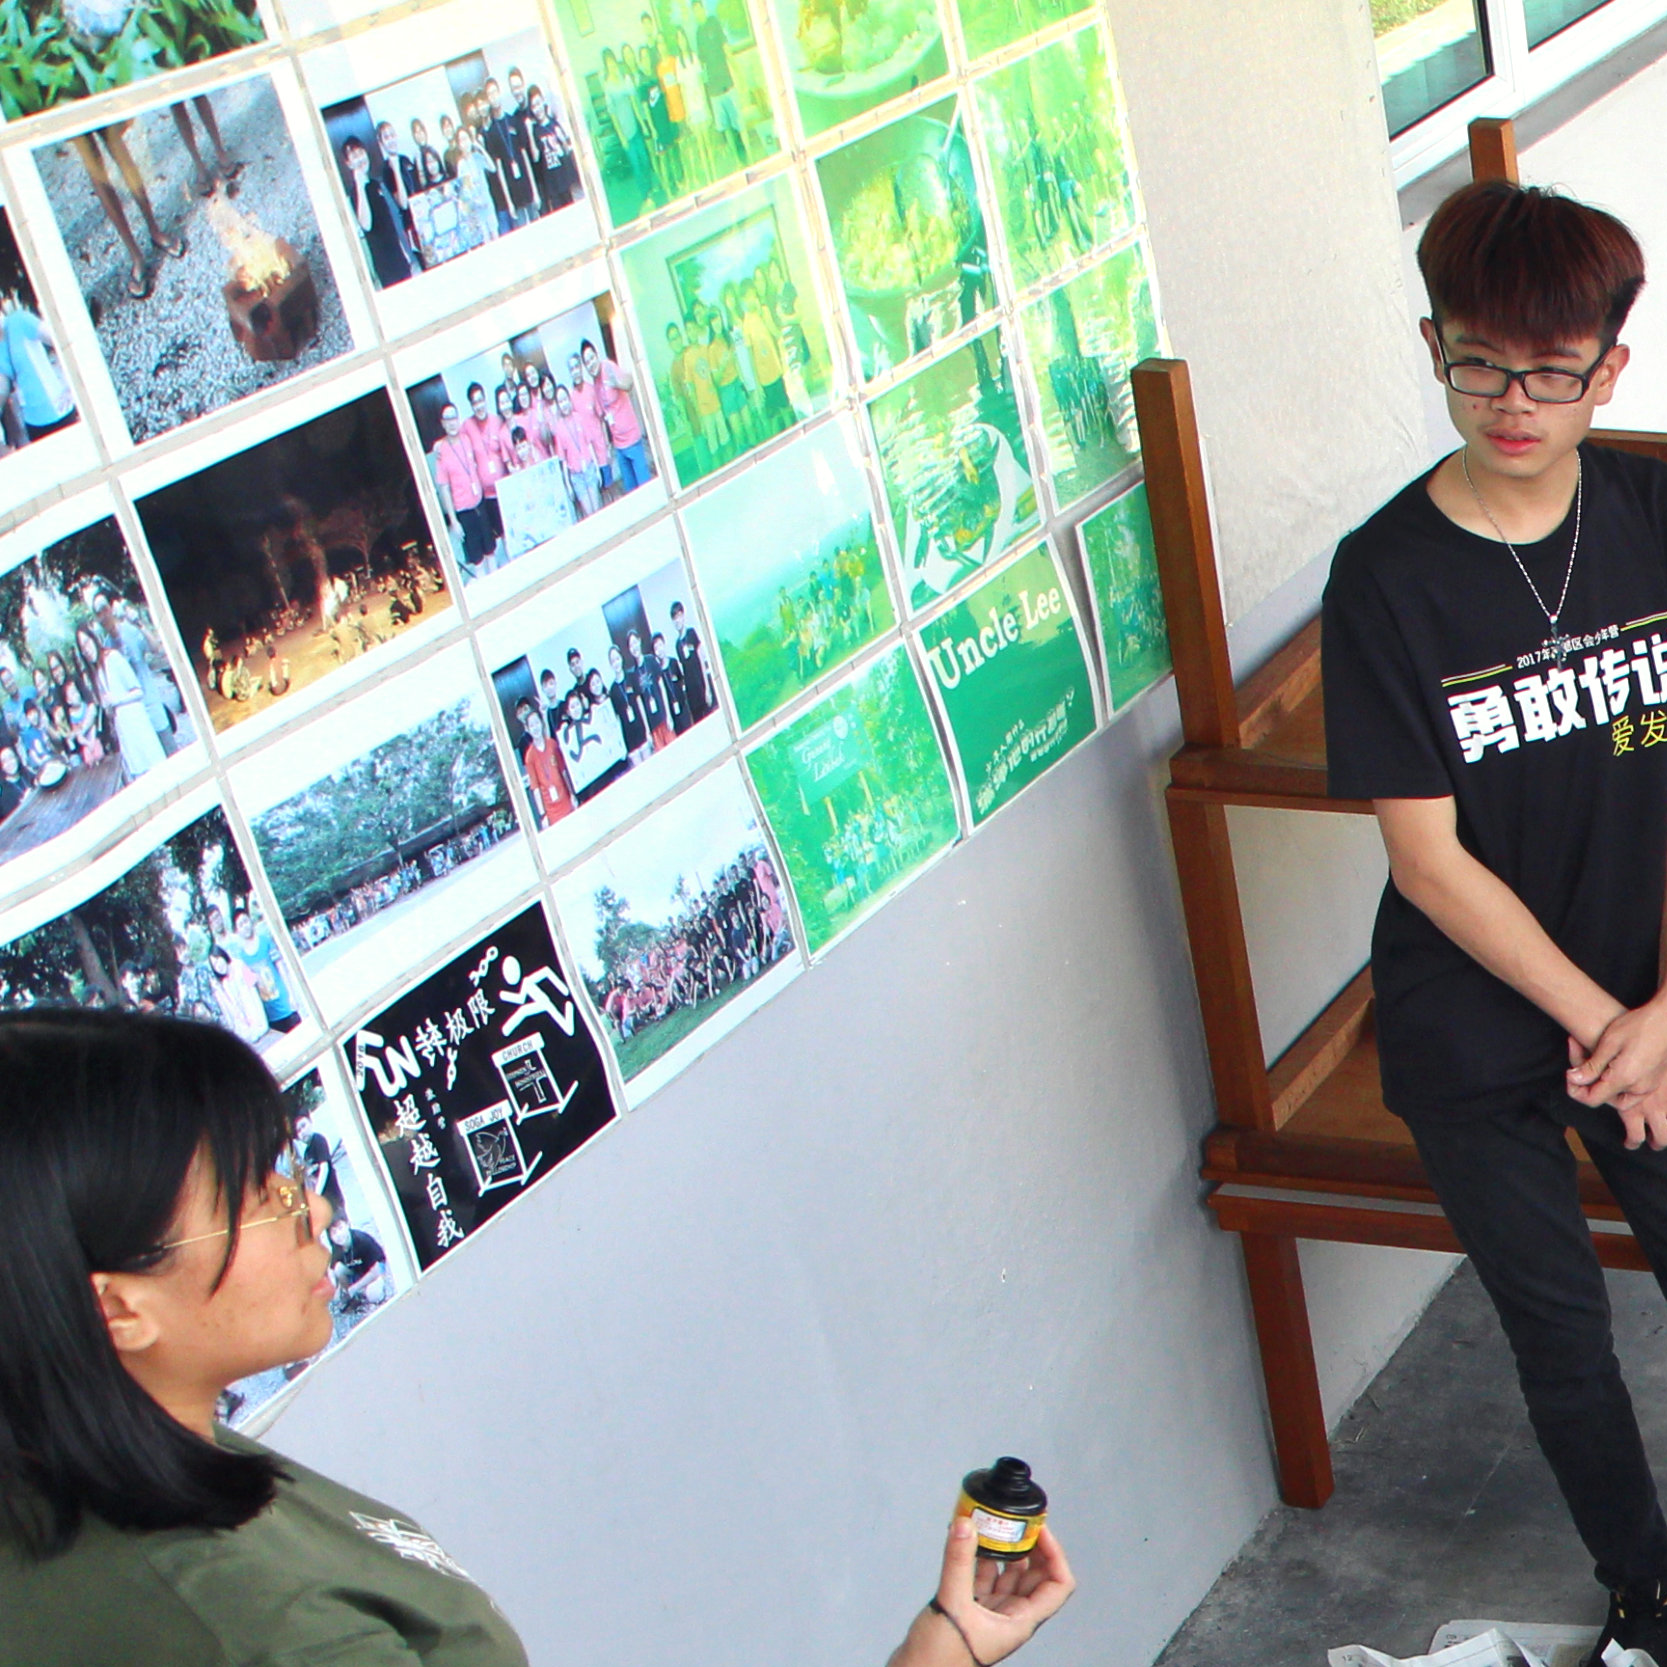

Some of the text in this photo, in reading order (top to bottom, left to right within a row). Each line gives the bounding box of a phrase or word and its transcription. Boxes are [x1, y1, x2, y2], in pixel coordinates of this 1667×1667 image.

[927, 586, 1062, 690] Uncle Lee
[503, 1040, 534, 1060] CHURCH
[464, 1115, 487, 1132] SOGA
[394, 1093, 465, 1247] 超越自我
